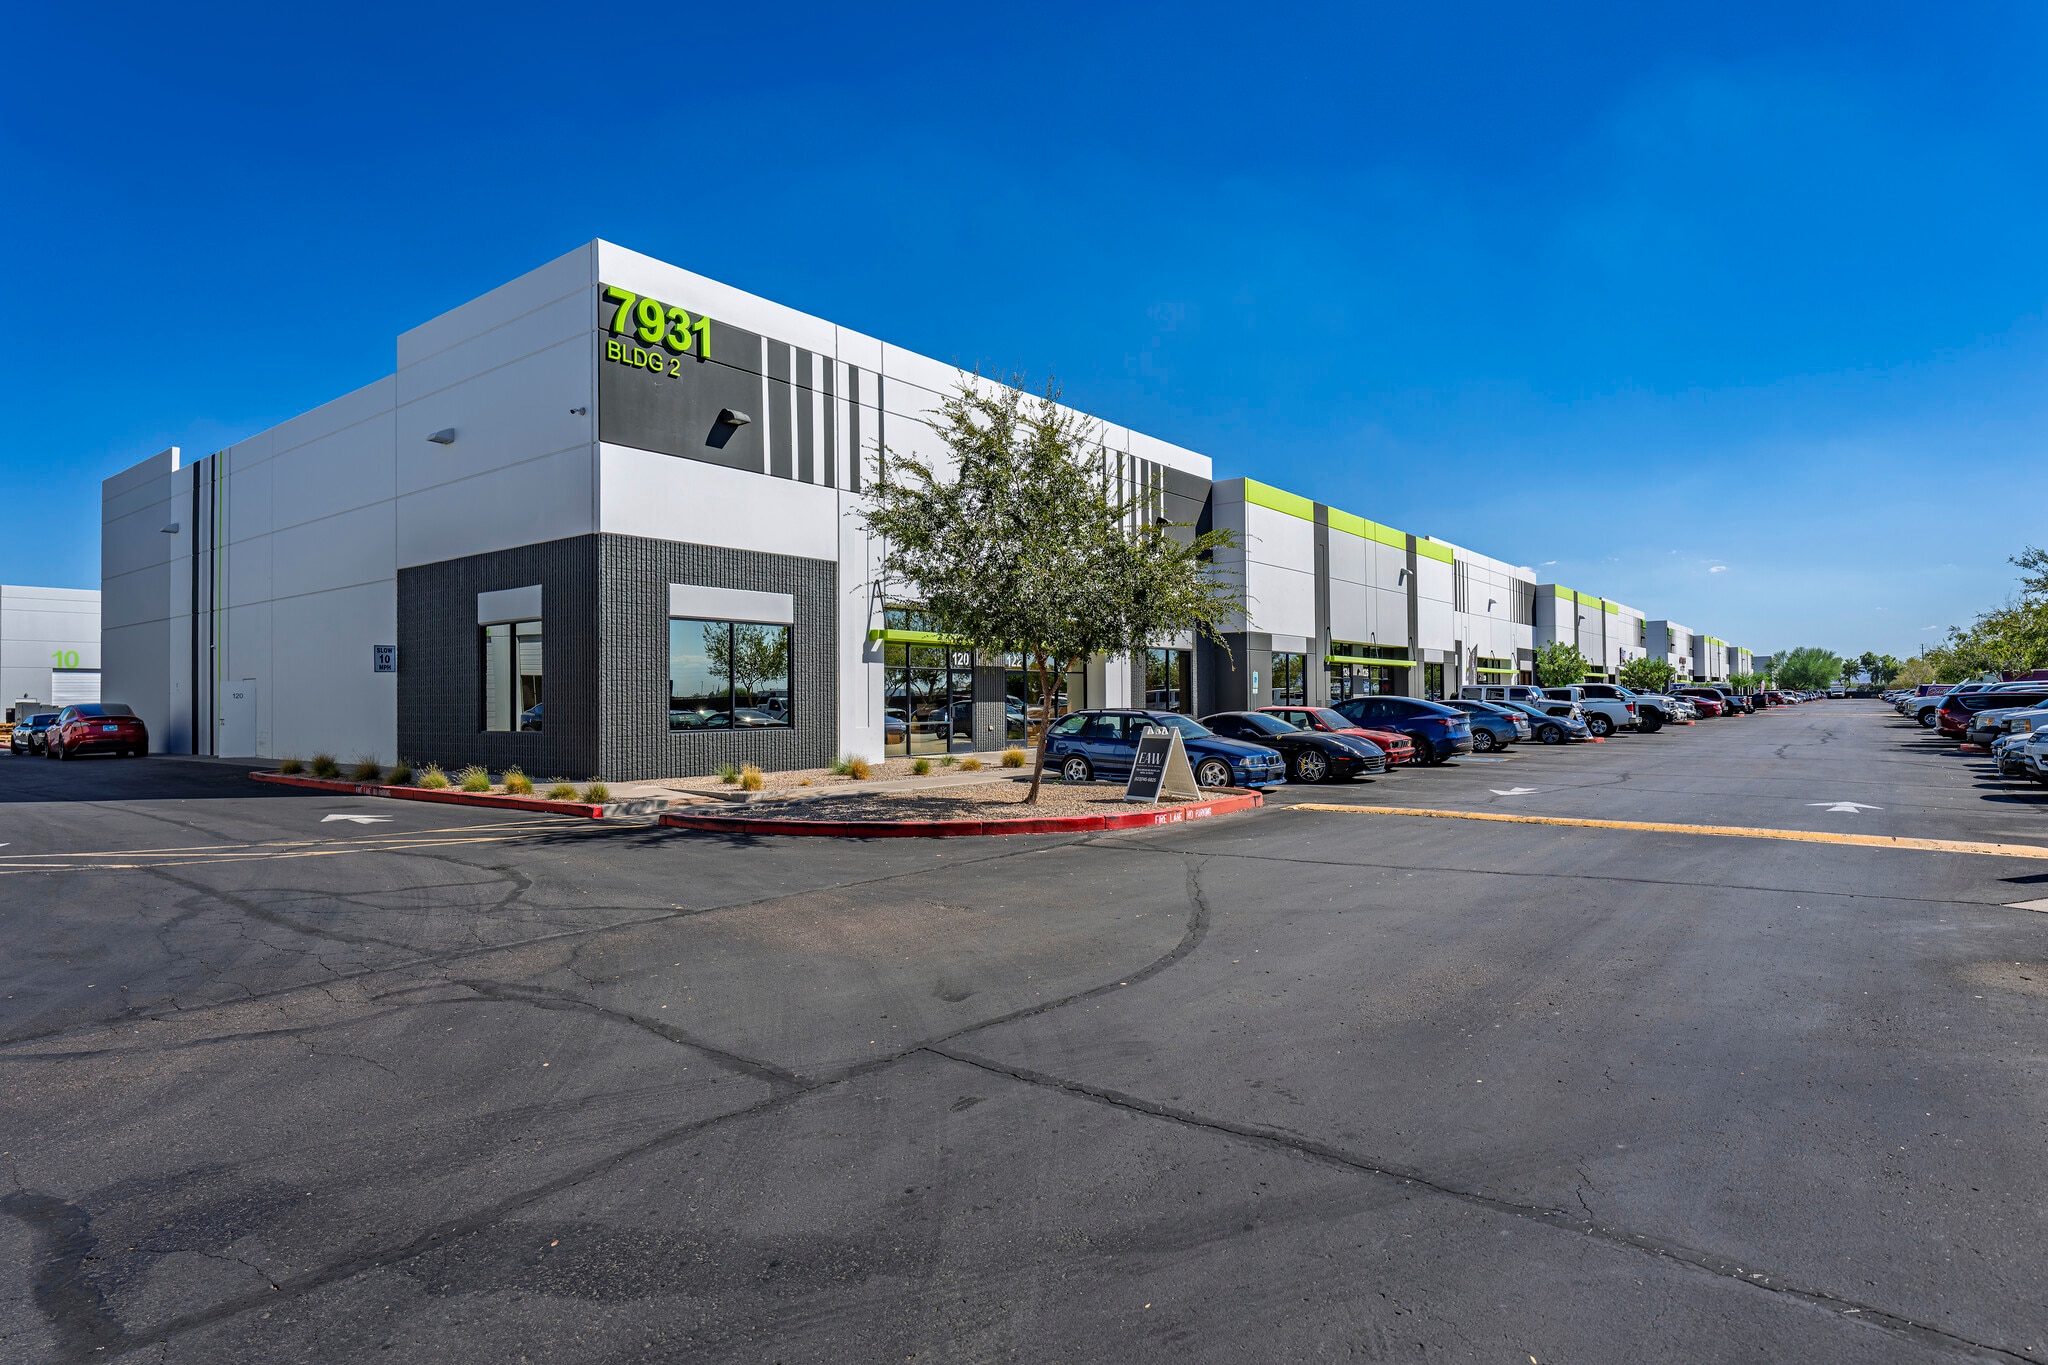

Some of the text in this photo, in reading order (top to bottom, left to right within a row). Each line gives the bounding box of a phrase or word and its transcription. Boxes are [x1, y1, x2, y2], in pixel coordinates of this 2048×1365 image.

[607, 285, 711, 358] 7931
[608, 339, 681, 377] BLDG 2
[52, 649, 80, 668] 10
[379, 654, 391, 664] 10
[952, 651, 970, 666] 120
[1138, 752, 1164, 765] EAW
[1154, 807, 1212, 824] FIRE LANE NO PARKING
